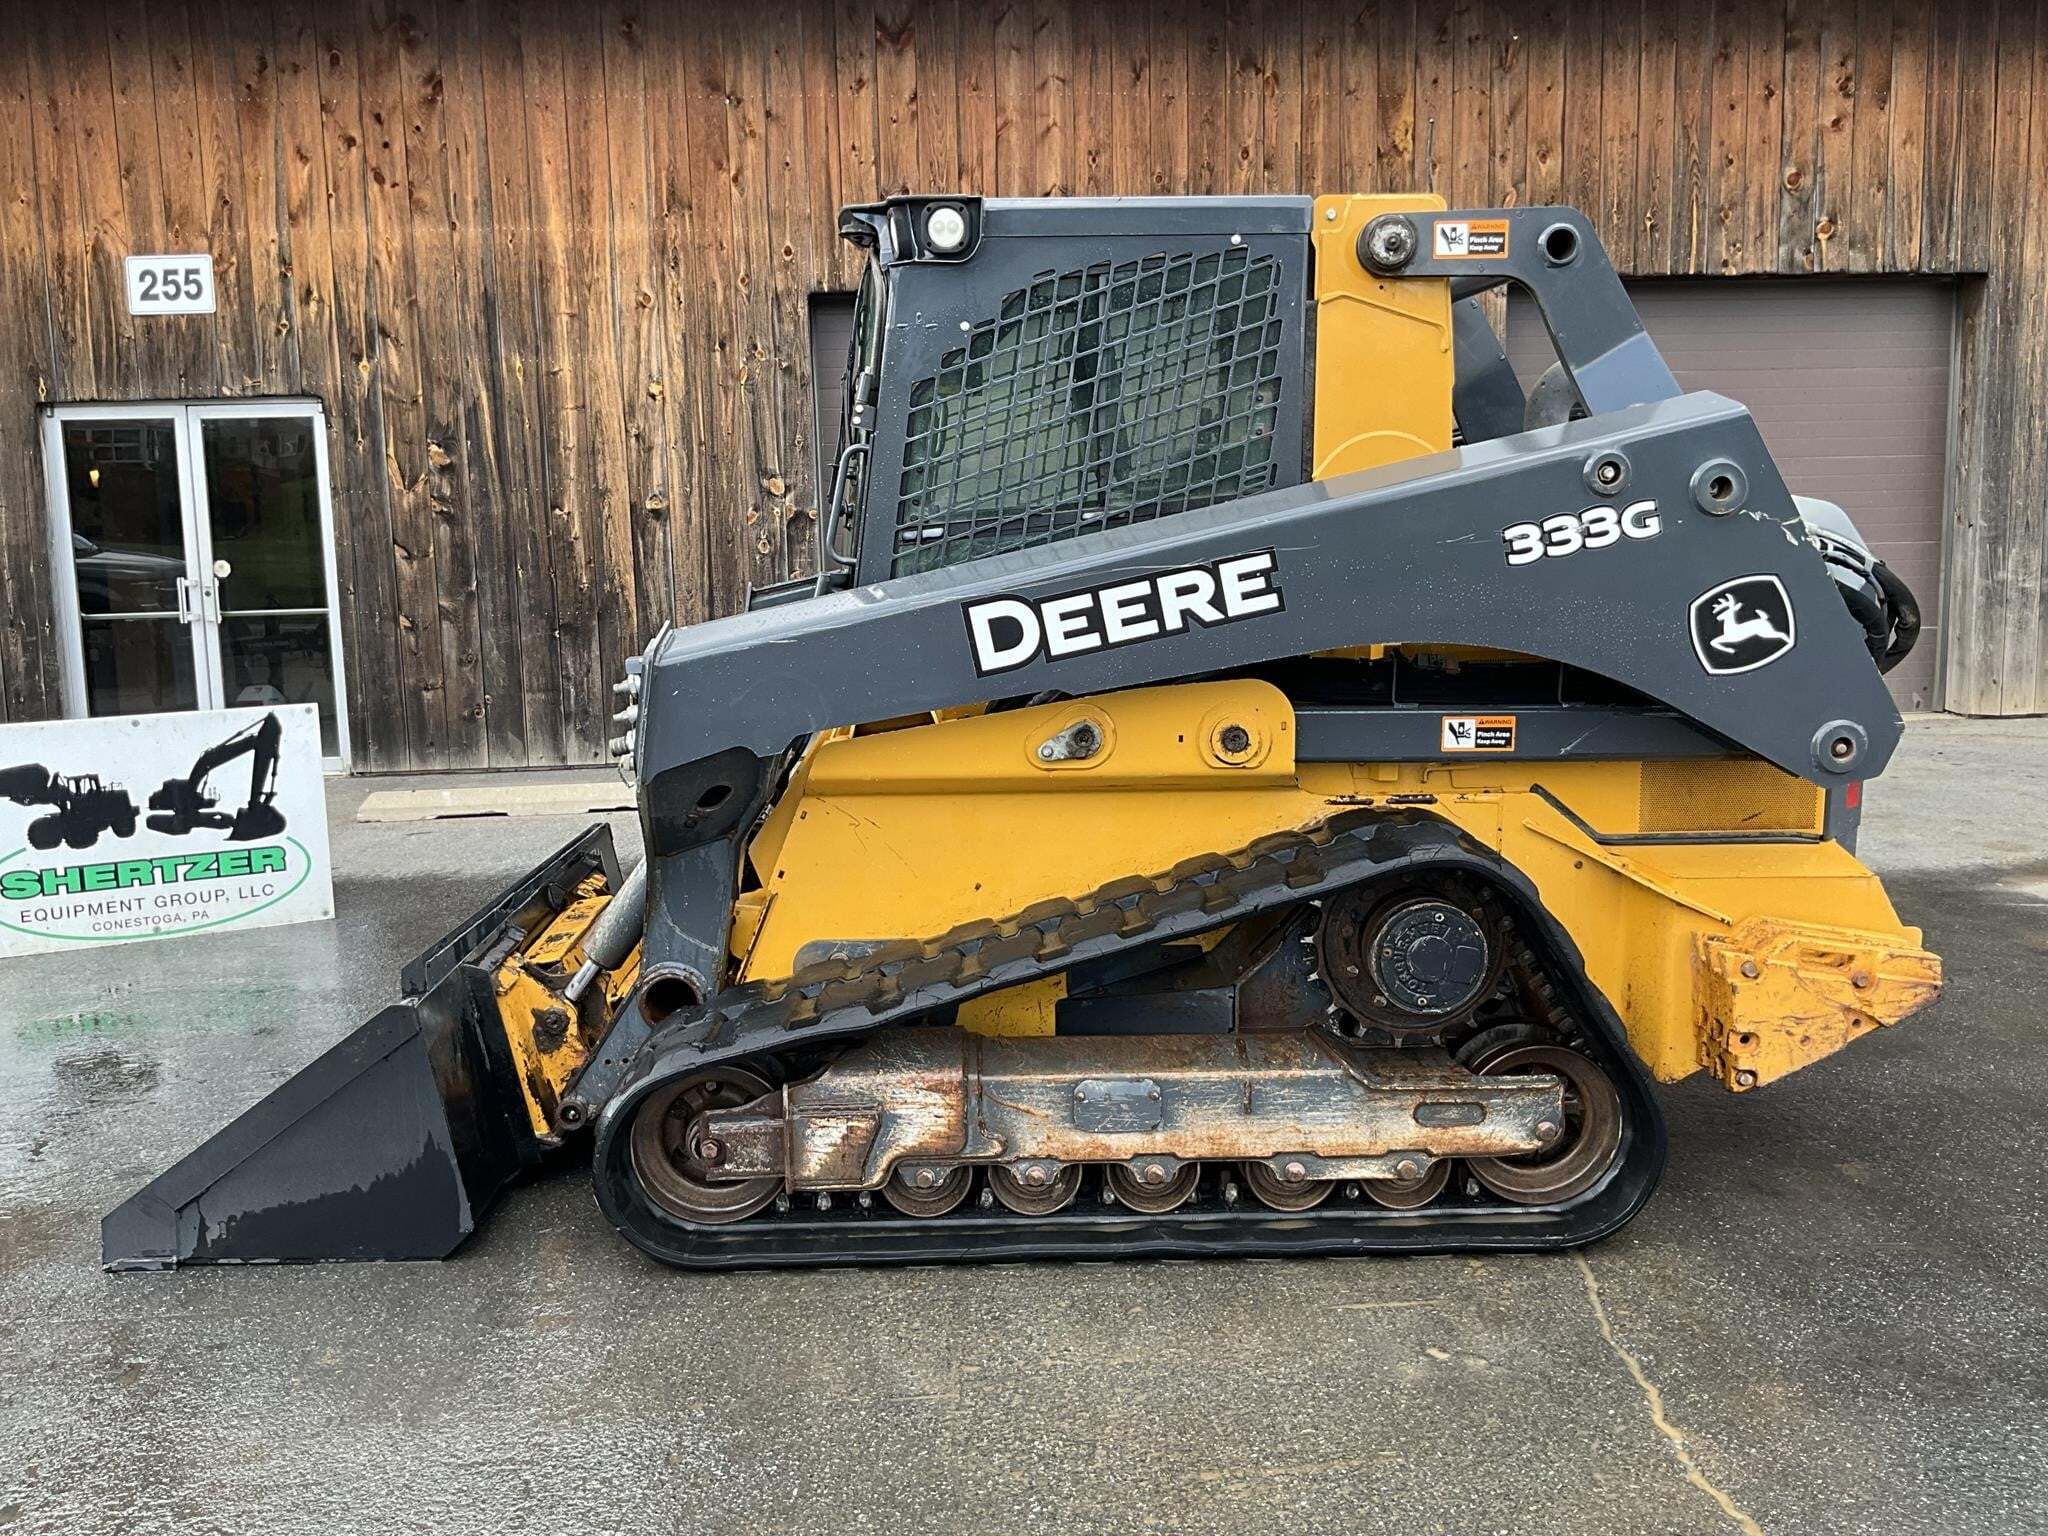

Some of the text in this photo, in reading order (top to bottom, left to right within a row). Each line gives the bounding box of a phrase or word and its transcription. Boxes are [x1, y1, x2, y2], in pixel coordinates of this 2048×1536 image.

[139, 268, 203, 301] 255
[1502, 499, 1663, 567] 333G
[966, 551, 1282, 674] DEERE
[1, 846, 287, 900] SHERTZER
[20, 883, 275, 924] EQUIPMENT GROUP, LLC
[92, 910, 210, 933] CONESTOGA, PA
